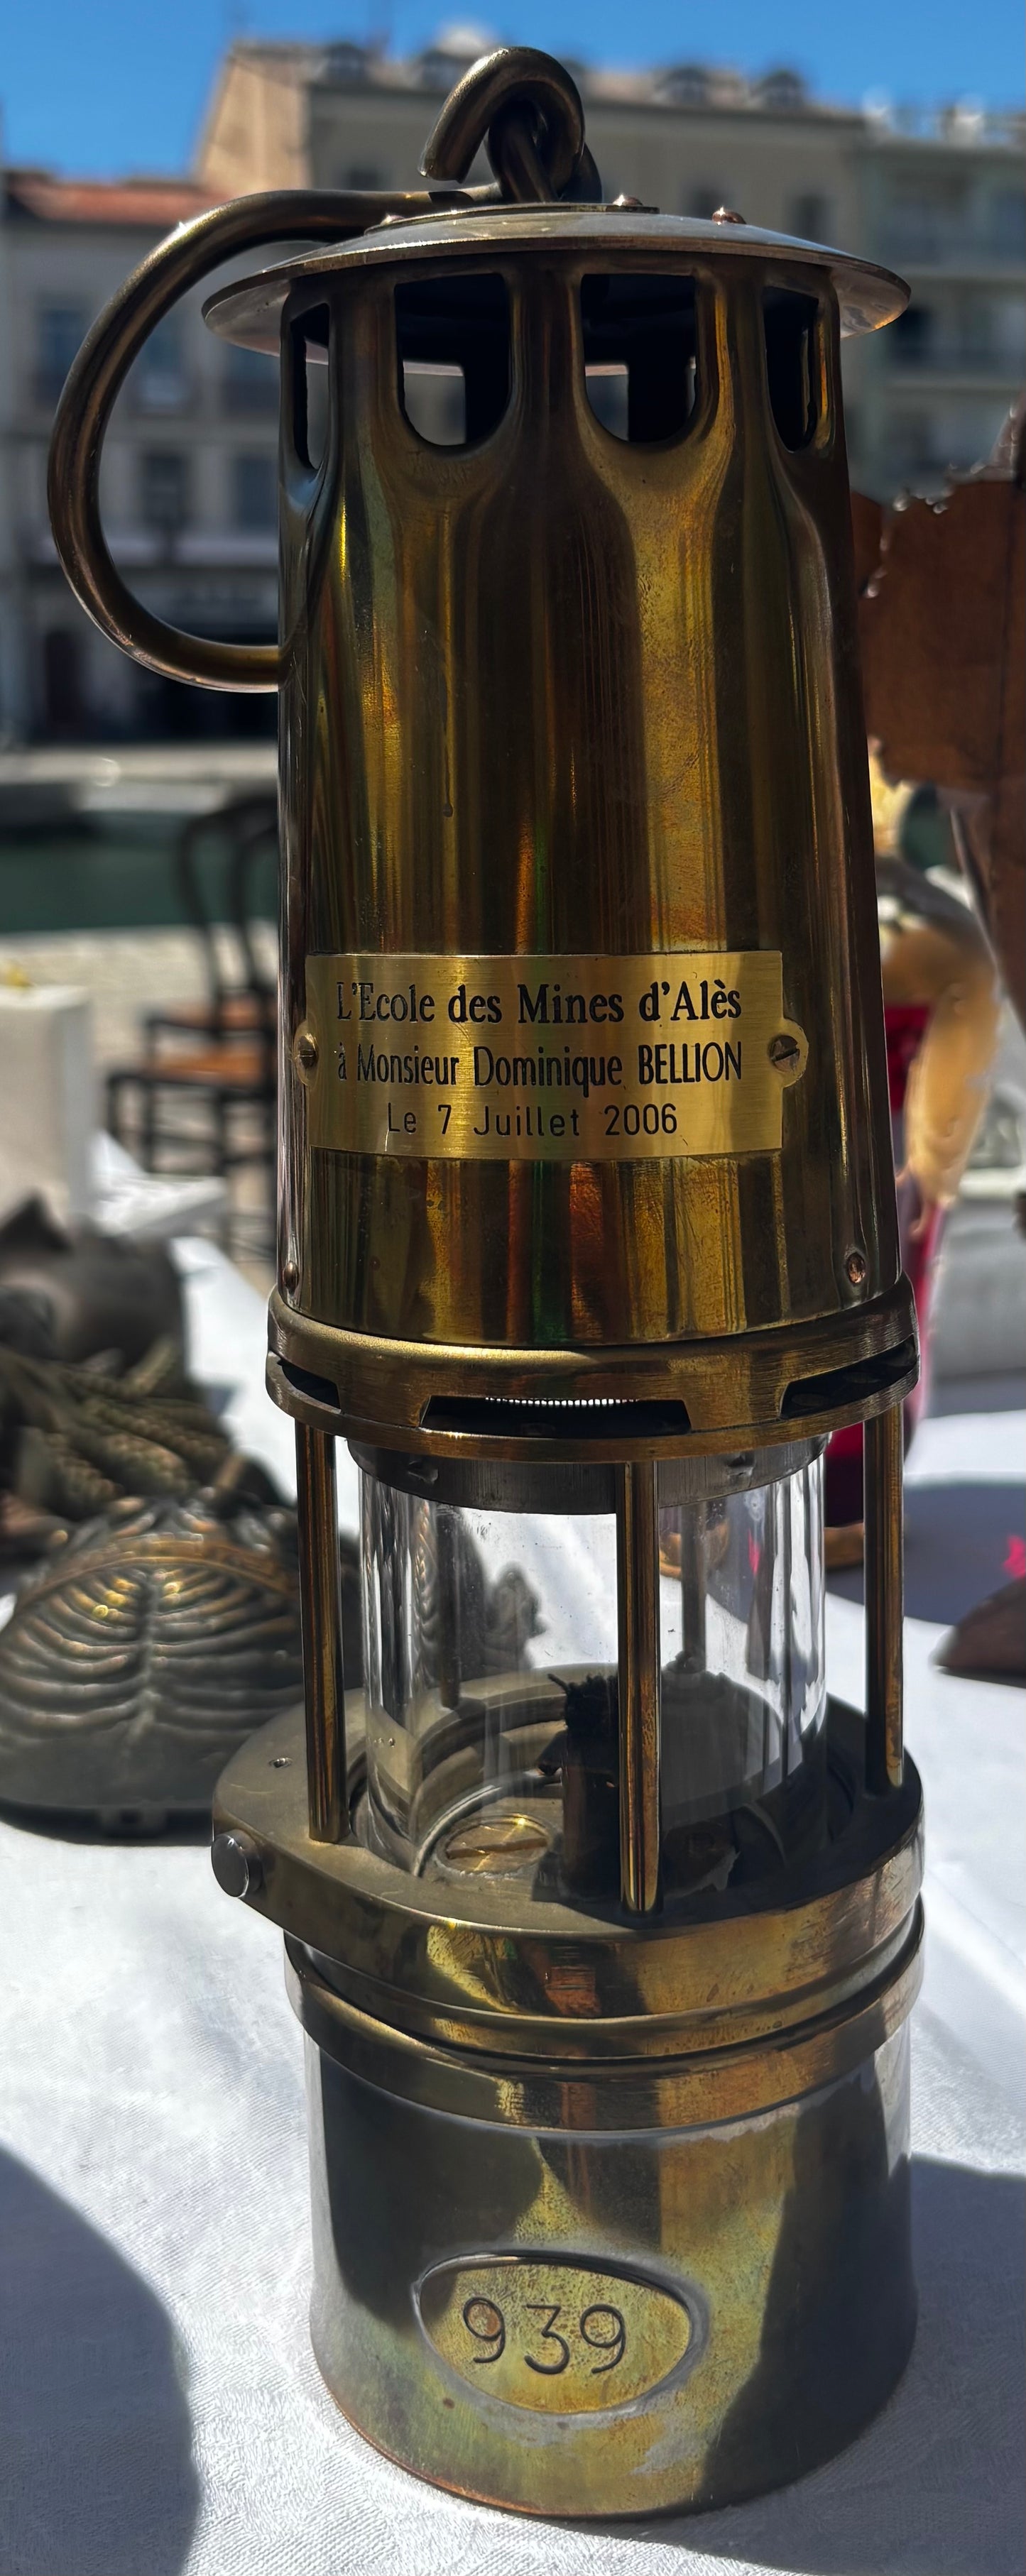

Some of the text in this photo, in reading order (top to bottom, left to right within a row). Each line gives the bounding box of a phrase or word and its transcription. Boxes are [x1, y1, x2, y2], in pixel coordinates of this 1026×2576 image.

[337, 979, 743, 1024] L'Ecole des Mines d'Alès
[337, 1041, 743, 1098] à Monsieur Dominique BELLION
[387, 1102, 678, 1137] Le 7 Juillet 2006
[462, 2296, 626, 2375] 939
